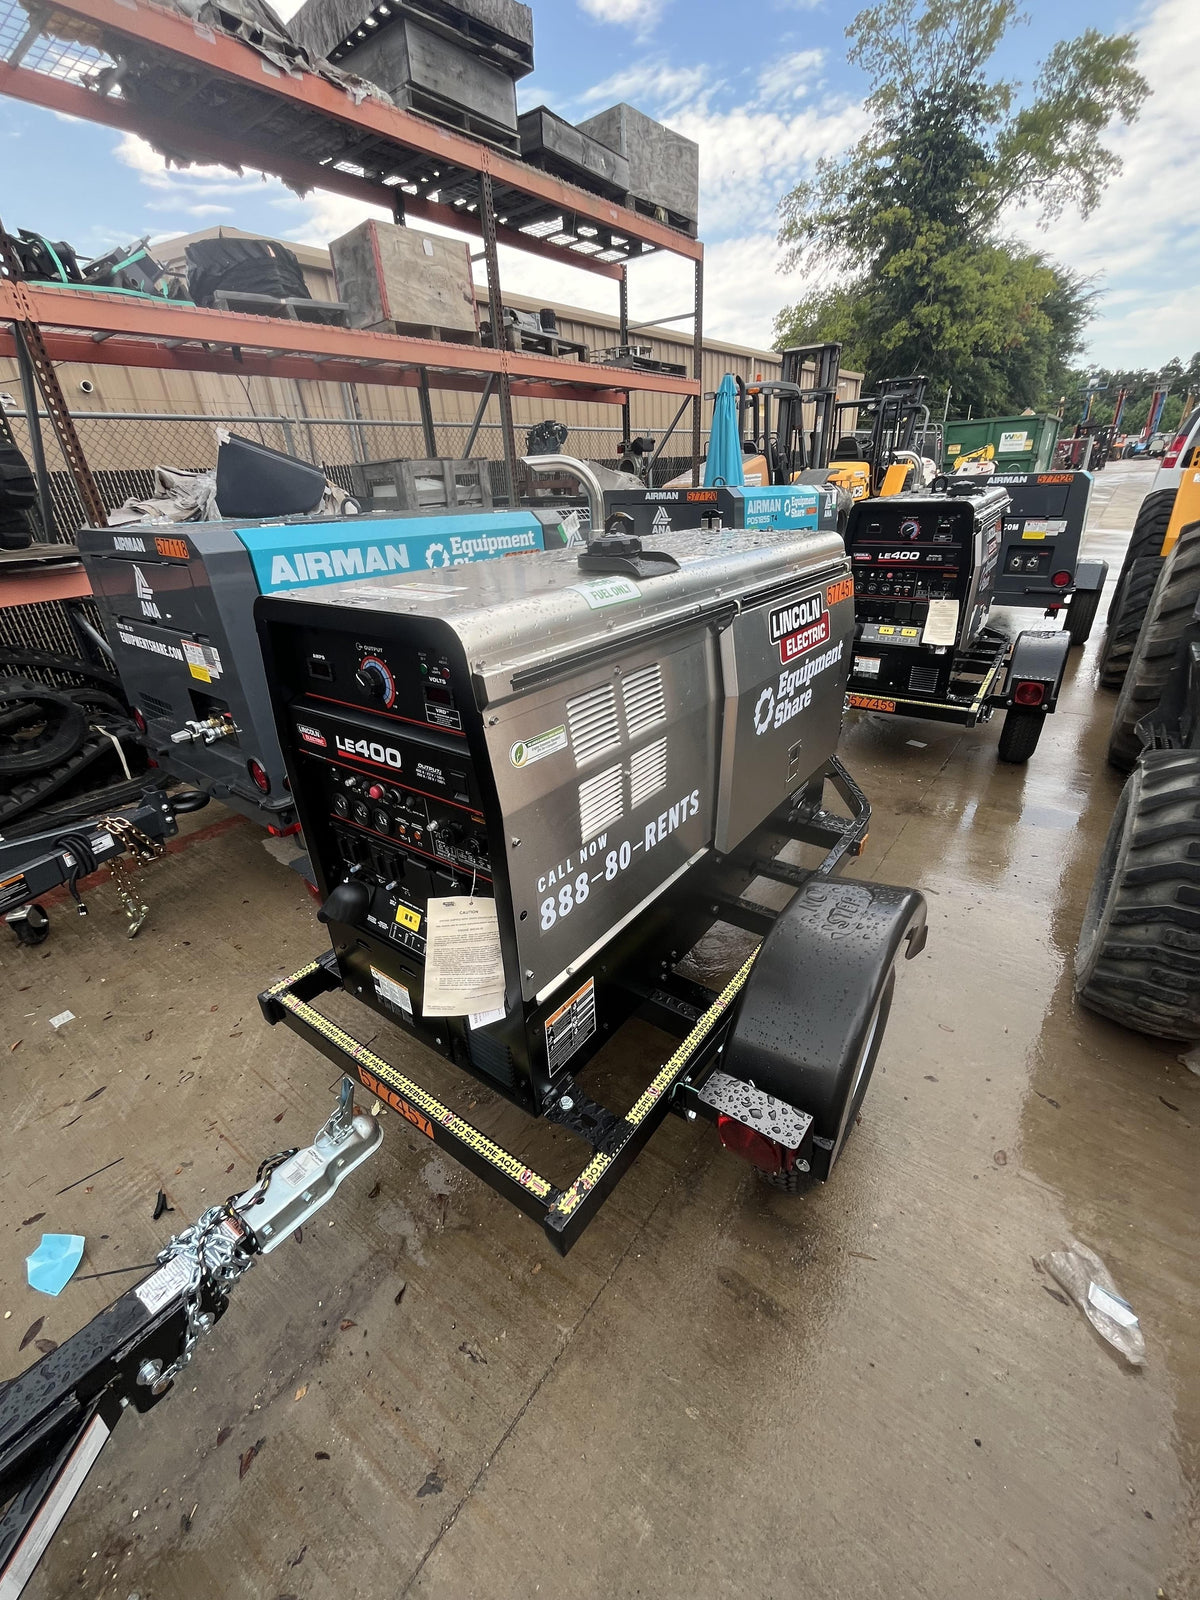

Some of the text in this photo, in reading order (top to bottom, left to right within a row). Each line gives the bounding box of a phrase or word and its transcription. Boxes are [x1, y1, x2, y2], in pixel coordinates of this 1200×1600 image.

[987, 475, 1028, 484] AIRMAN
[645, 491, 679, 501] AIRMAN
[747, 498, 781, 515] AIRMAN
[791, 496, 816, 508] Equipment
[791, 508, 805, 518] Share
[652, 525, 671, 534] ANA
[113, 536, 146, 553] AIRMAN
[156, 538, 189, 558] 577118
[450, 530, 535, 558] Equipment
[878, 551, 920, 560] LE400
[270, 543, 410, 585] AIRMAN
[590, 584, 632, 601] FUEL ONLY
[827, 579, 853, 605] 577457
[141, 600, 162, 619] ANA
[772, 597, 820, 639] LINCOLN
[118, 631, 185, 661] EQUIPMENTSHARE.COM
[363, 645, 383, 653] OUTPUT
[786, 622, 826, 657] ELECTRIC
[428, 676, 447, 686] VOLTS
[777, 639, 844, 700] Equipment
[773, 688, 813, 729] Share
[850, 695, 894, 711] 577459
[298, 725, 320, 738] LINCOLN
[336, 735, 402, 768] LE400
[537, 832, 608, 893] CALL NOW
[540, 788, 699, 931] 888-80-RENTS
[798, 886, 828, 912] NO
[827, 896, 860, 930] STEP
[722, 969, 747, 1002] NO SE PARE
[299, 1006, 355, 1050] DO NOT STAND HERE
[656, 1007, 719, 1089] NE PAS TENEZ DEBOUT ICI
[360, 1052, 444, 1117] NE PAS TENEZ DEBOUT ICI
[360, 1068, 430, 1132] 577457
[633, 1095, 653, 1118] HERE
[451, 1120, 521, 1175] NO SE PARE AQUI
[587, 1153, 608, 1182] DO NO
